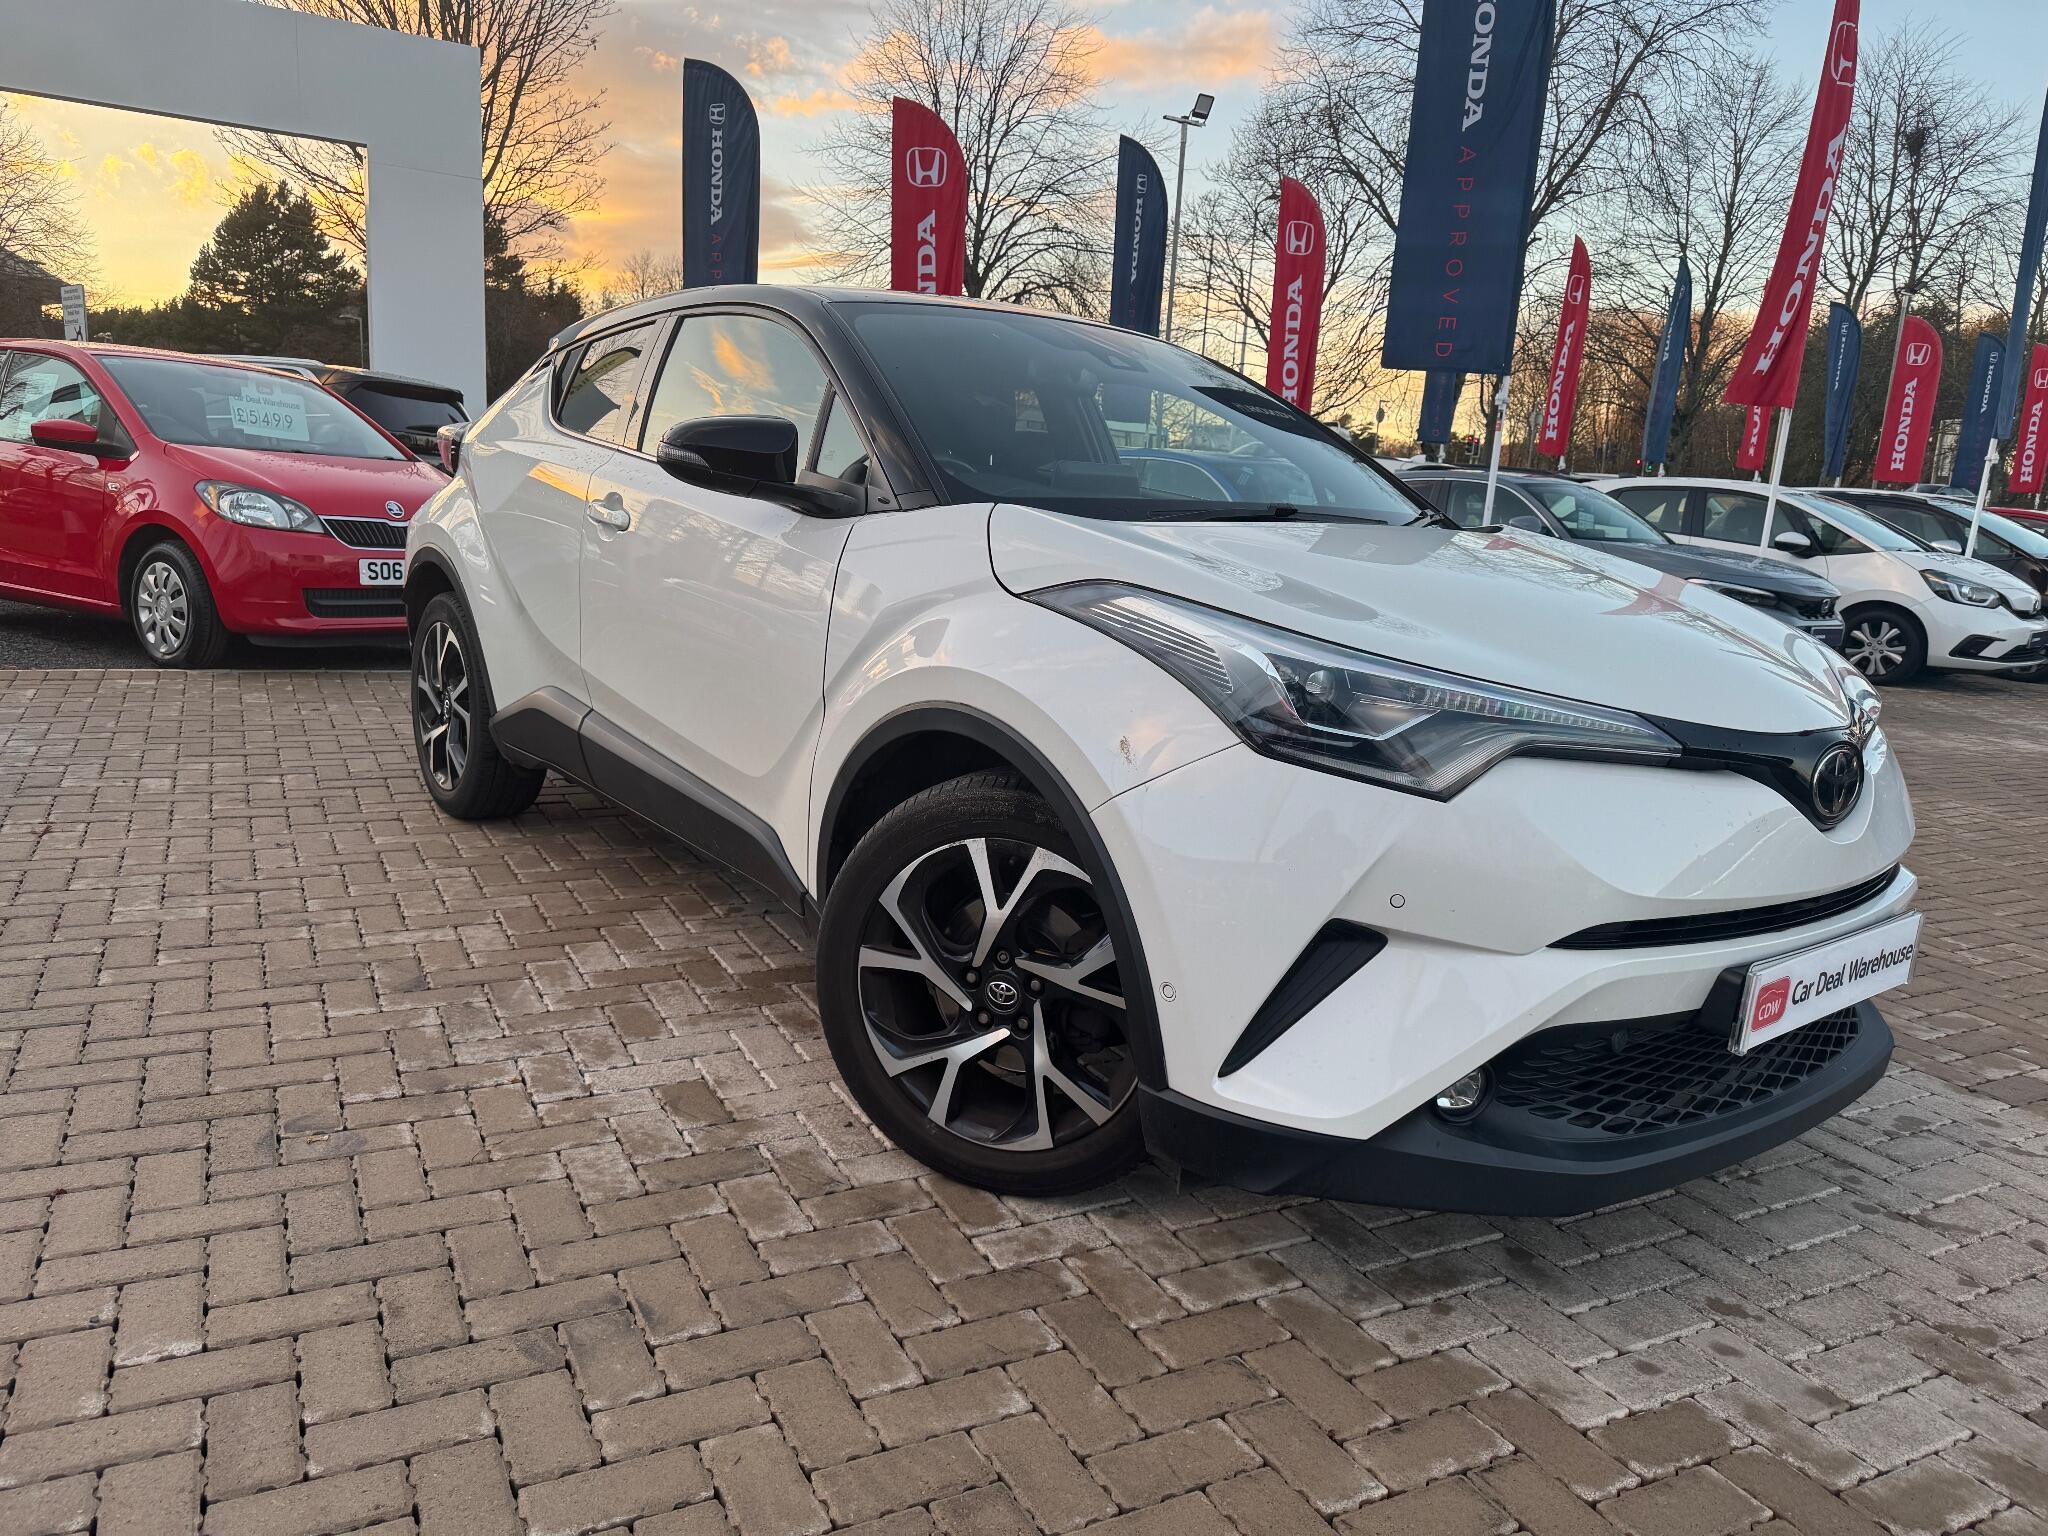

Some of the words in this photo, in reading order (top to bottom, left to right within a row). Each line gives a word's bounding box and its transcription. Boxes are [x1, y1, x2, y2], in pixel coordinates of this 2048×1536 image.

[1462, 0, 1497, 132] ONDA
[710, 127, 723, 226] HONDA
[917, 209, 937, 294] NDA
[1130, 197, 1144, 286] HONDA
[1436, 146, 1479, 358] APPROVED
[1752, 121, 1848, 376] HONDA
[236, 407, 293, 429] £5499
[1890, 377, 1918, 471] HONDA
[1980, 363, 1995, 415] HONDA
[2019, 399, 2044, 483] HONDA
[1758, 999, 1782, 1021] CDW
[1792, 980, 1816, 1006] Car
[1815, 963, 1846, 997] Deal
[1848, 943, 1914, 983] Warehouse
